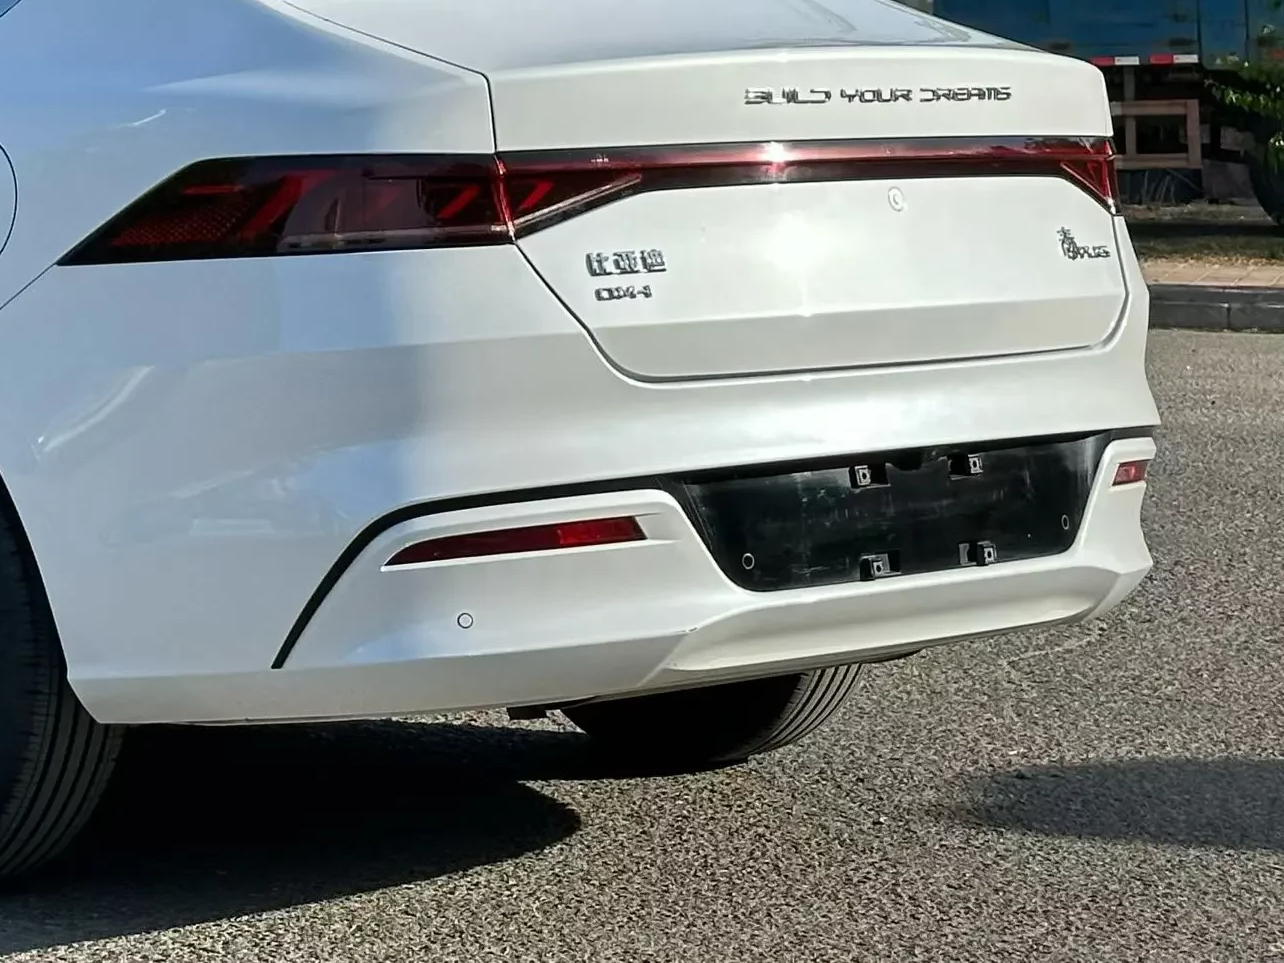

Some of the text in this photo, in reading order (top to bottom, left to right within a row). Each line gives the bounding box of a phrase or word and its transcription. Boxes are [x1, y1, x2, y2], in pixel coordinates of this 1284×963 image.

[744, 86, 1012, 105] BUILD YOUR DREAMS
[585, 248, 667, 277] 比亚迪
